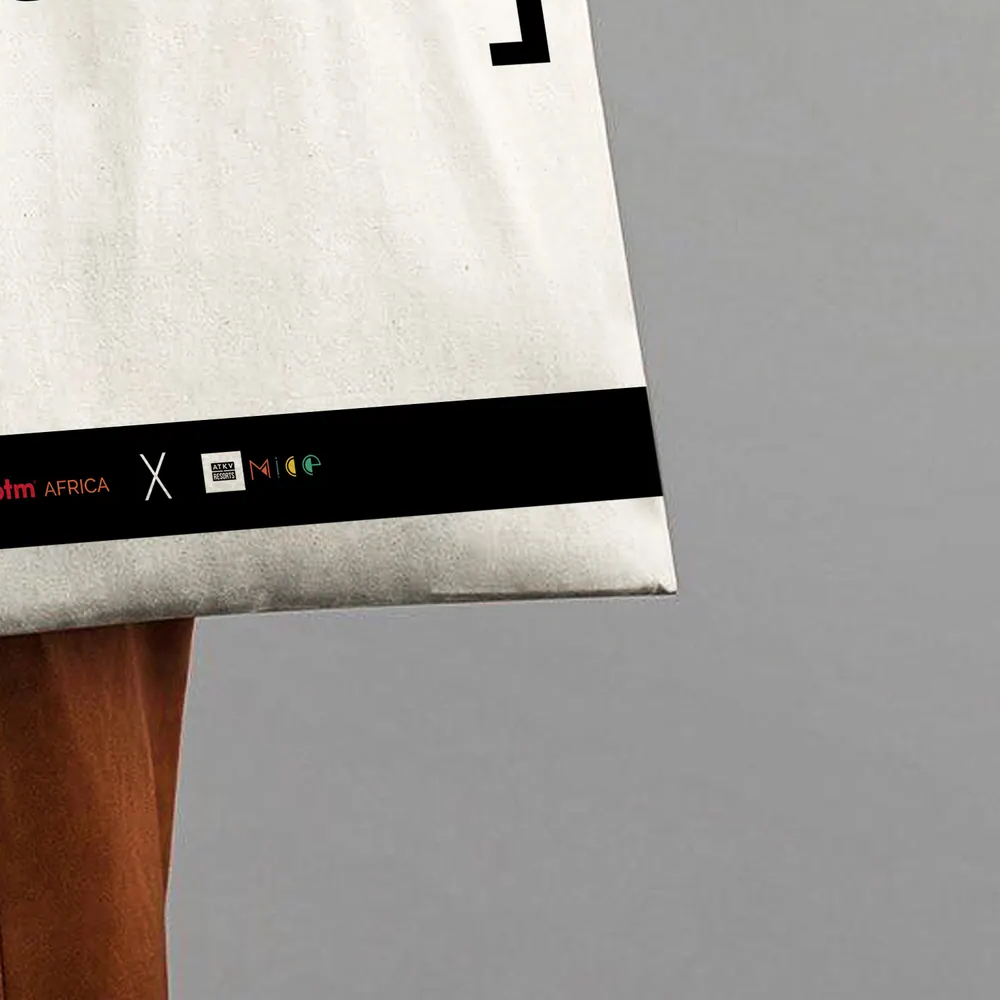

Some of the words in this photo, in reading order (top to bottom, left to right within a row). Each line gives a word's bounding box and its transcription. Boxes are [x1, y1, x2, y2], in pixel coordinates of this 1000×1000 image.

[212, 463, 234, 471] ATKV
[213, 472, 236, 481] RESORTS
[44, 477, 110, 497] AFRICA
